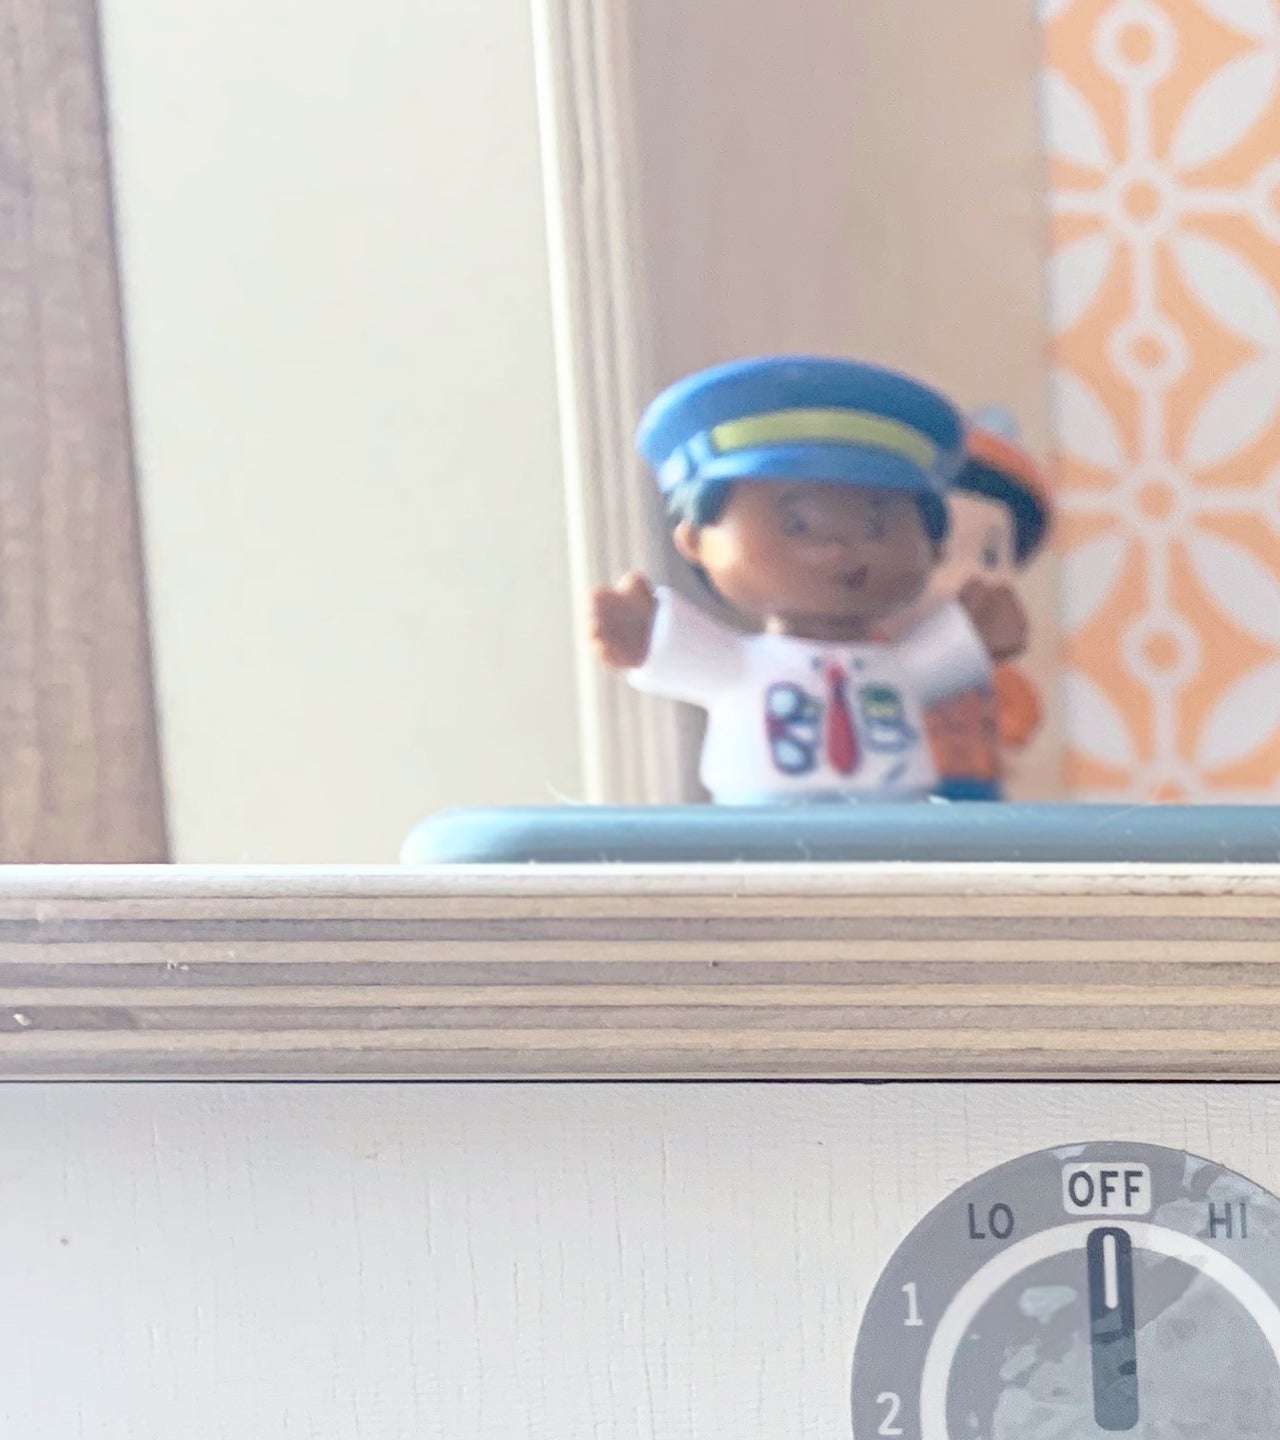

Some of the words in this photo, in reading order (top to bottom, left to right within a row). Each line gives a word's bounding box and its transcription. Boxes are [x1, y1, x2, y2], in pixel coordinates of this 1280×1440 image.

[1067, 1170, 1144, 1208] OFF
[967, 1202, 1015, 1240] LO
[1208, 1202, 1249, 1239] HI
[901, 1282, 923, 1326] 1
[875, 1392, 903, 1436] 2
